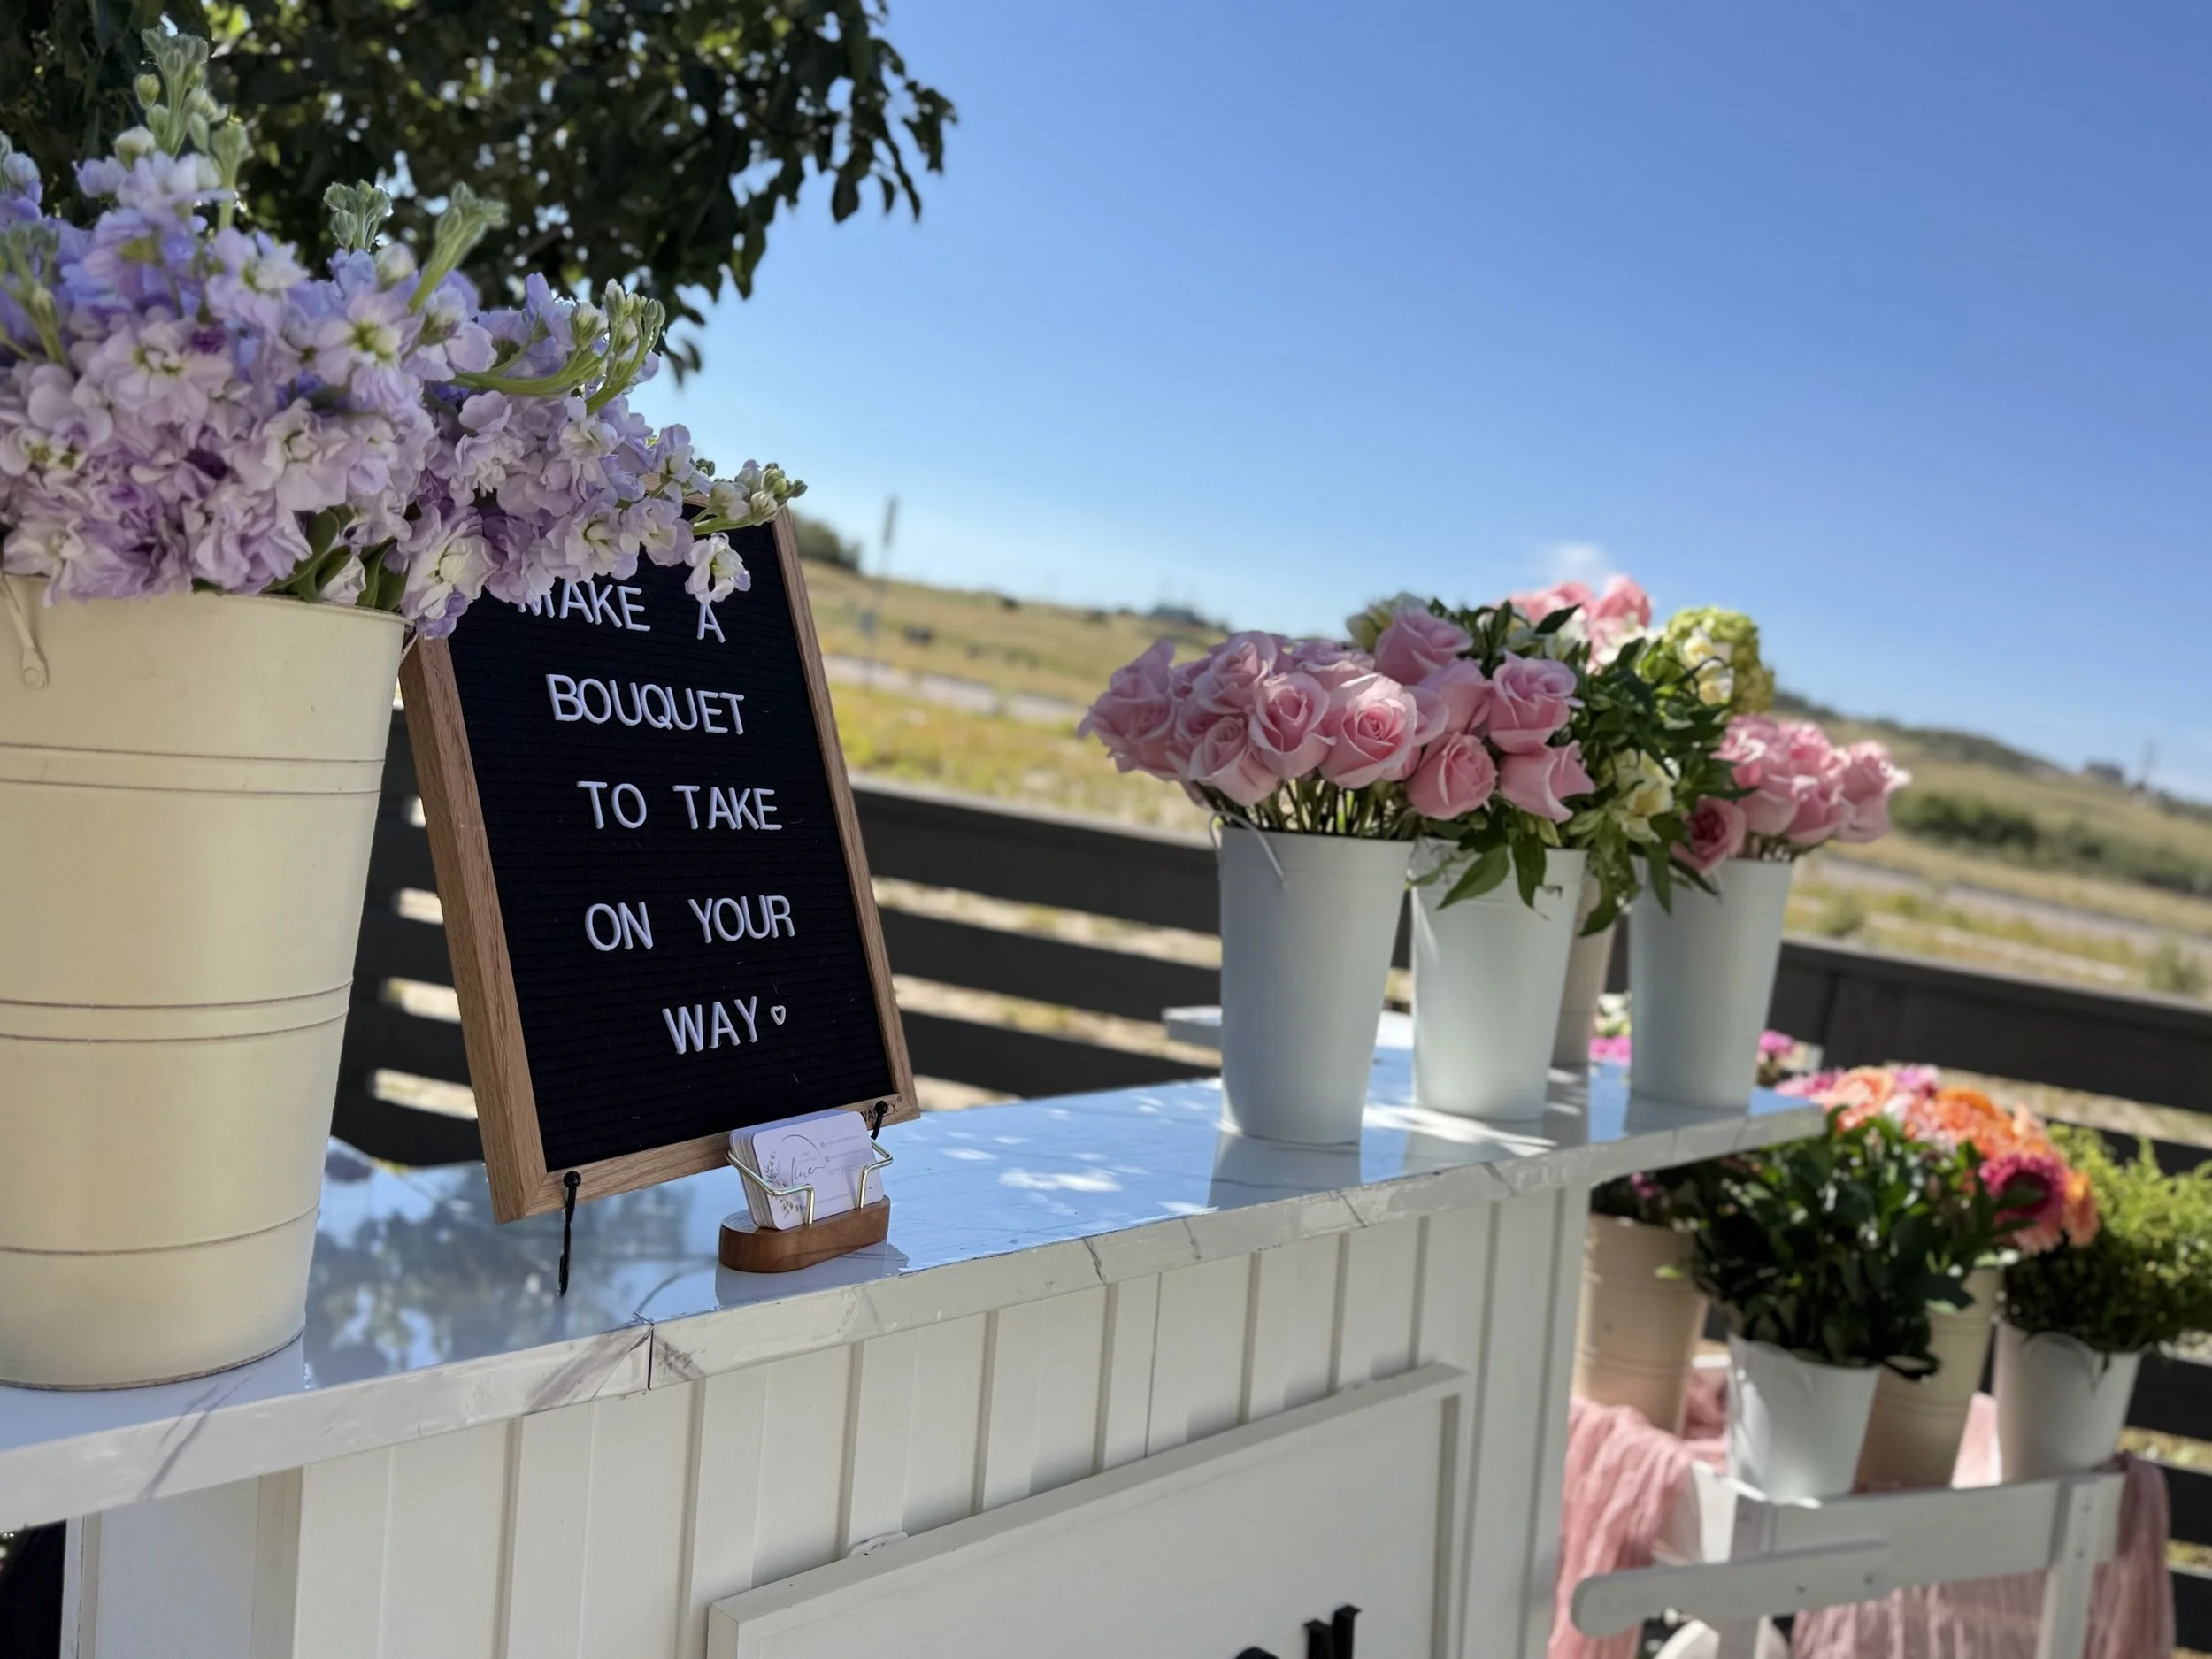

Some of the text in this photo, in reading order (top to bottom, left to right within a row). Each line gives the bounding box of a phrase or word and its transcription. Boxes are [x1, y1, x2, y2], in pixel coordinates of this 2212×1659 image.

[696, 602, 726, 643] A
[545, 673, 745, 735] BOUQUET
[576, 780, 783, 830] TO TAKE
[584, 895, 796, 952] ON YOUR
[661, 995, 758, 1055] WAY
